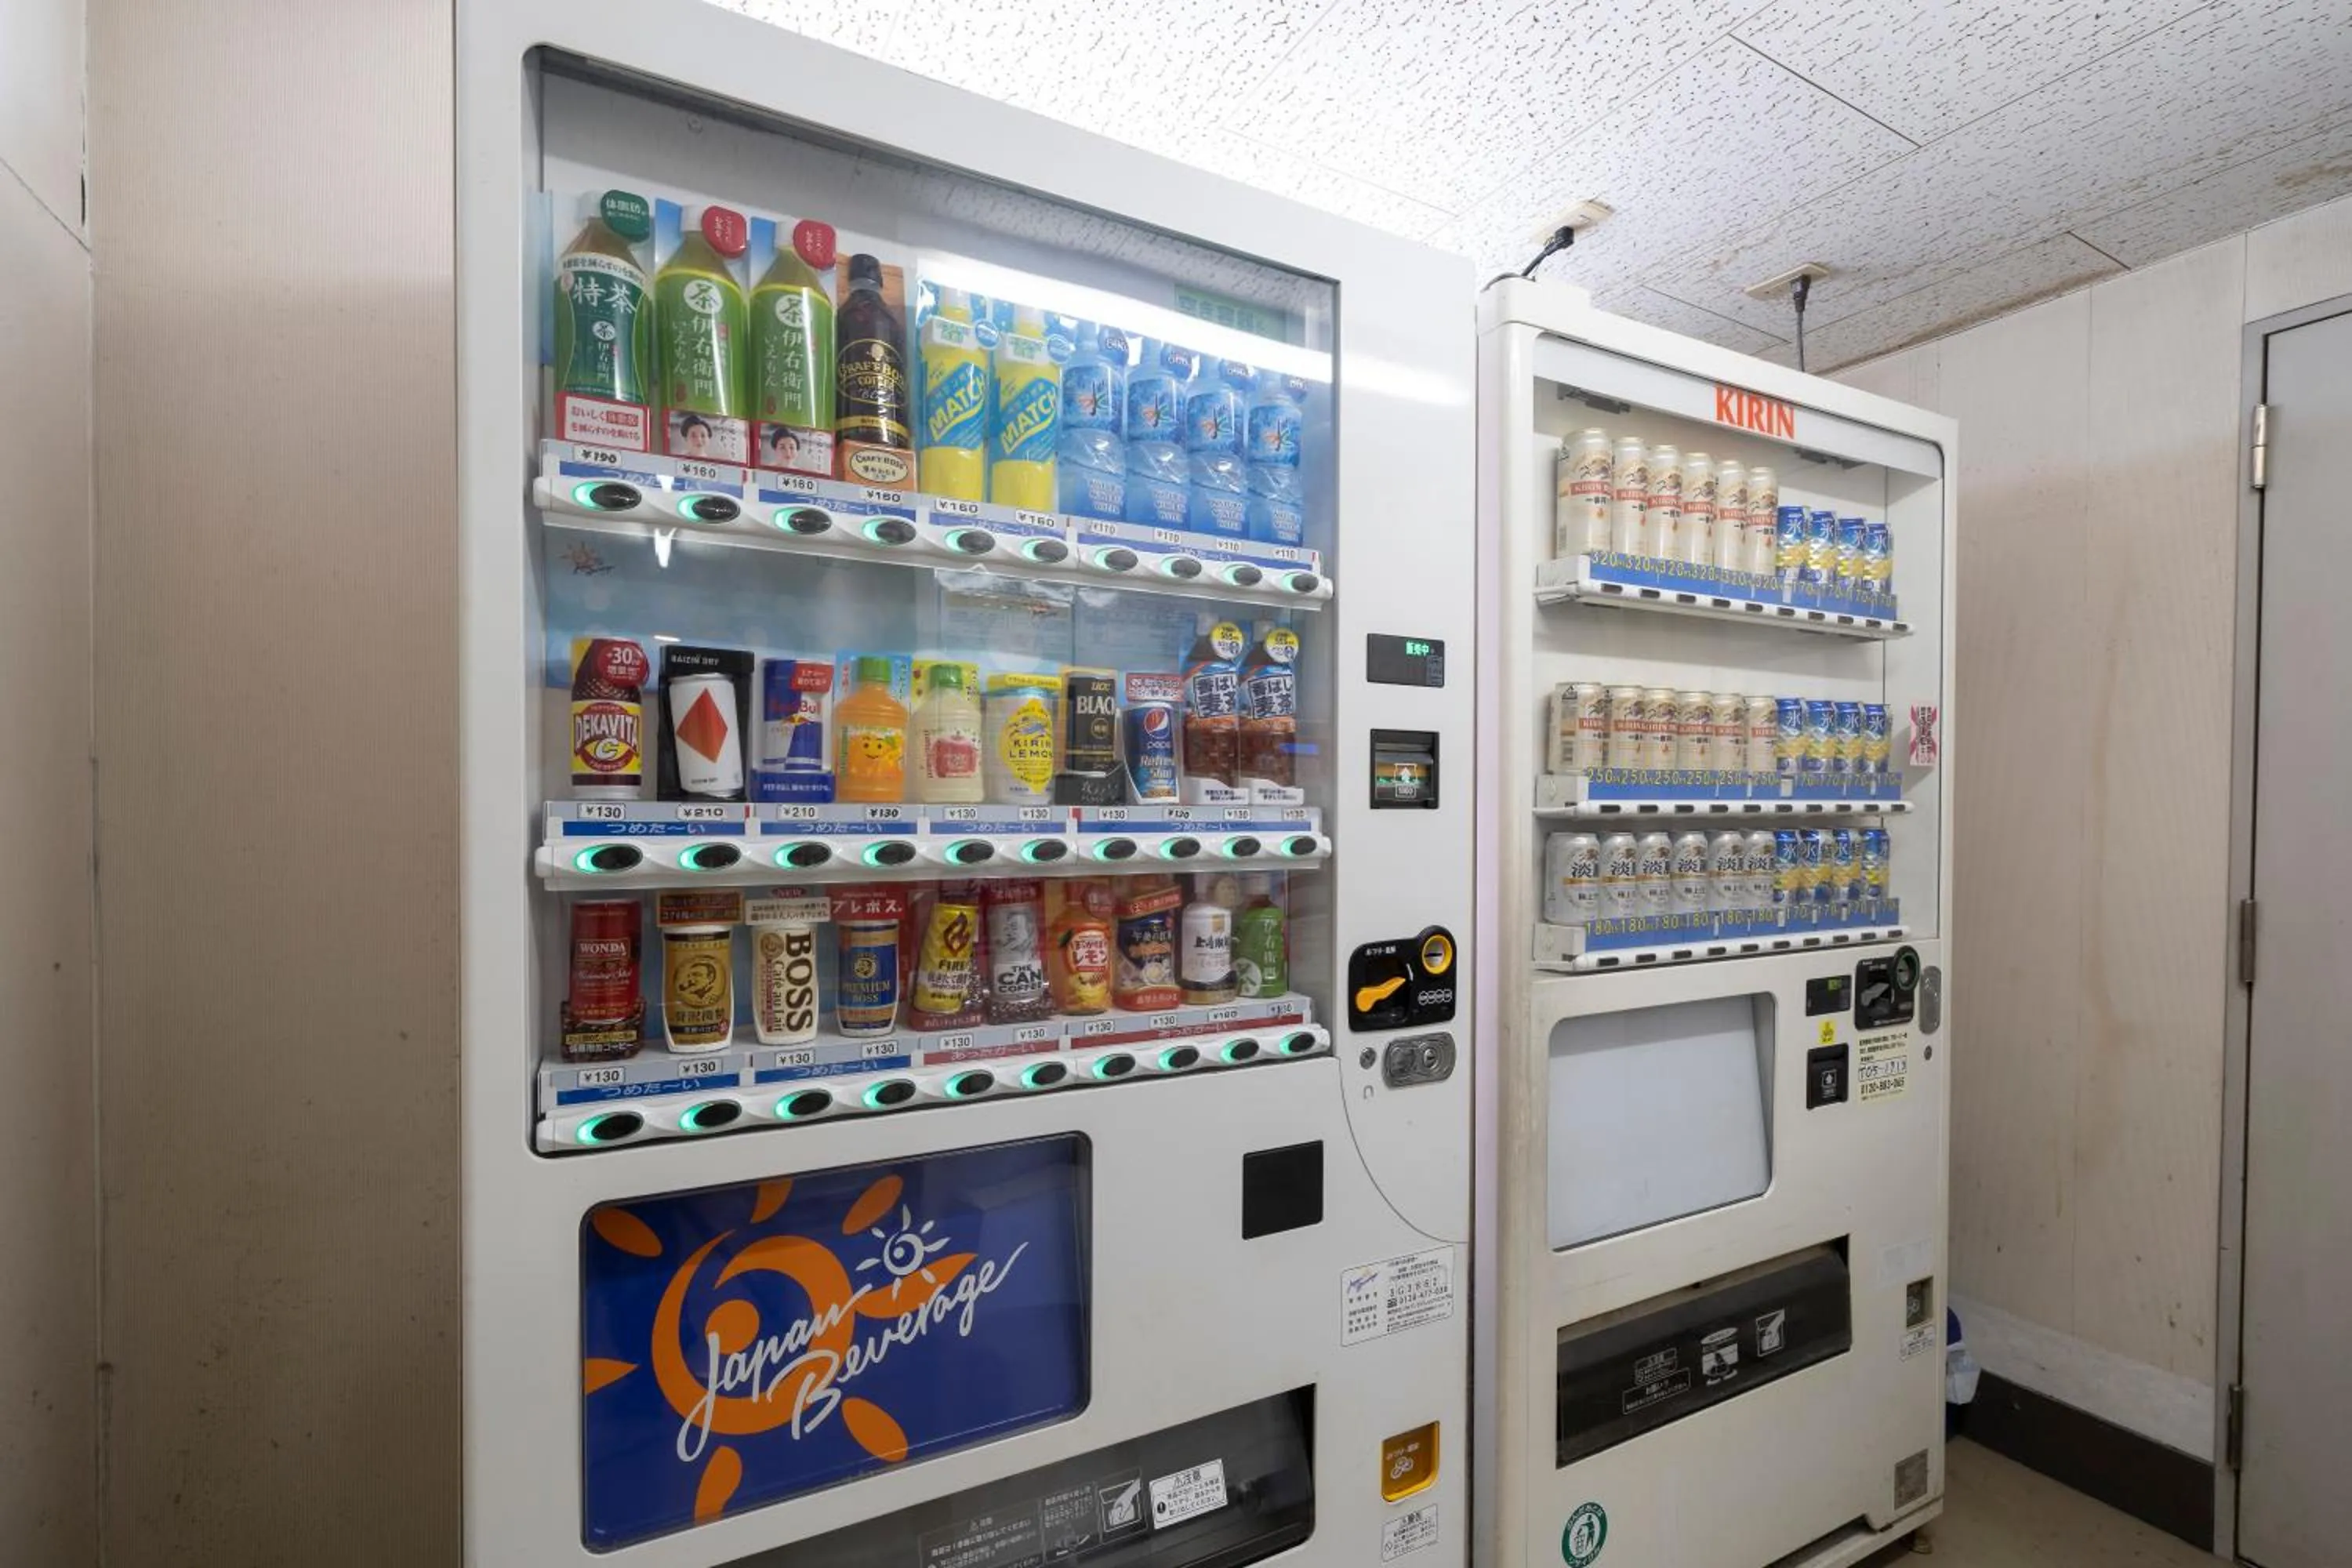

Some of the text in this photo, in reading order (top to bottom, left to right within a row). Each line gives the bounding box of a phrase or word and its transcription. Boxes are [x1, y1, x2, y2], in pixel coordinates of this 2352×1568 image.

[572, 277, 637, 314] 特茶
[690, 283, 719, 310] 茶
[1716, 386, 1794, 439] KIRIN
[581, 449, 617, 463] ¥190
[682, 464, 716, 478] ¥160
[783, 477, 815, 490] ¥160
[866, 489, 901, 503] ¥160
[940, 501, 978, 514] ¥160
[1018, 513, 1054, 528] ¥160
[1076, 695, 1115, 715] BLAC
[1254, 693, 1292, 717] 麦茶
[575, 713, 639, 750] DEKAVITA
[594, 738, 619, 760] C
[586, 805, 622, 818] ¥130
[683, 808, 724, 818] ¥210
[784, 807, 815, 818] ¥210
[870, 808, 899, 818] ¥130
[949, 808, 976, 818] ¥130
[1022, 808, 1048, 818] ¥130
[1102, 810, 1125, 819] ¥130
[1227, 810, 1248, 819] ¥130
[579, 942, 626, 956] WONDA
[1075, 948, 1108, 964] レモン
[786, 931, 813, 1033] BOSS
[998, 969, 1042, 986] CAN
[998, 982, 1044, 993] COFFEE
[1153, 1016, 1175, 1025] ¥130
[1021, 1029, 1045, 1039] ¥130
[1088, 1022, 1112, 1033] ¥130
[943, 1037, 970, 1047] ¥130
[867, 1044, 895, 1054] ¥130
[779, 1053, 810, 1064] ¥130
[684, 1062, 716, 1073] ¥130
[584, 1069, 620, 1083] ¥130
[766, 1242, 1029, 1439] Beverage
[677, 1283, 872, 1462] Japan
